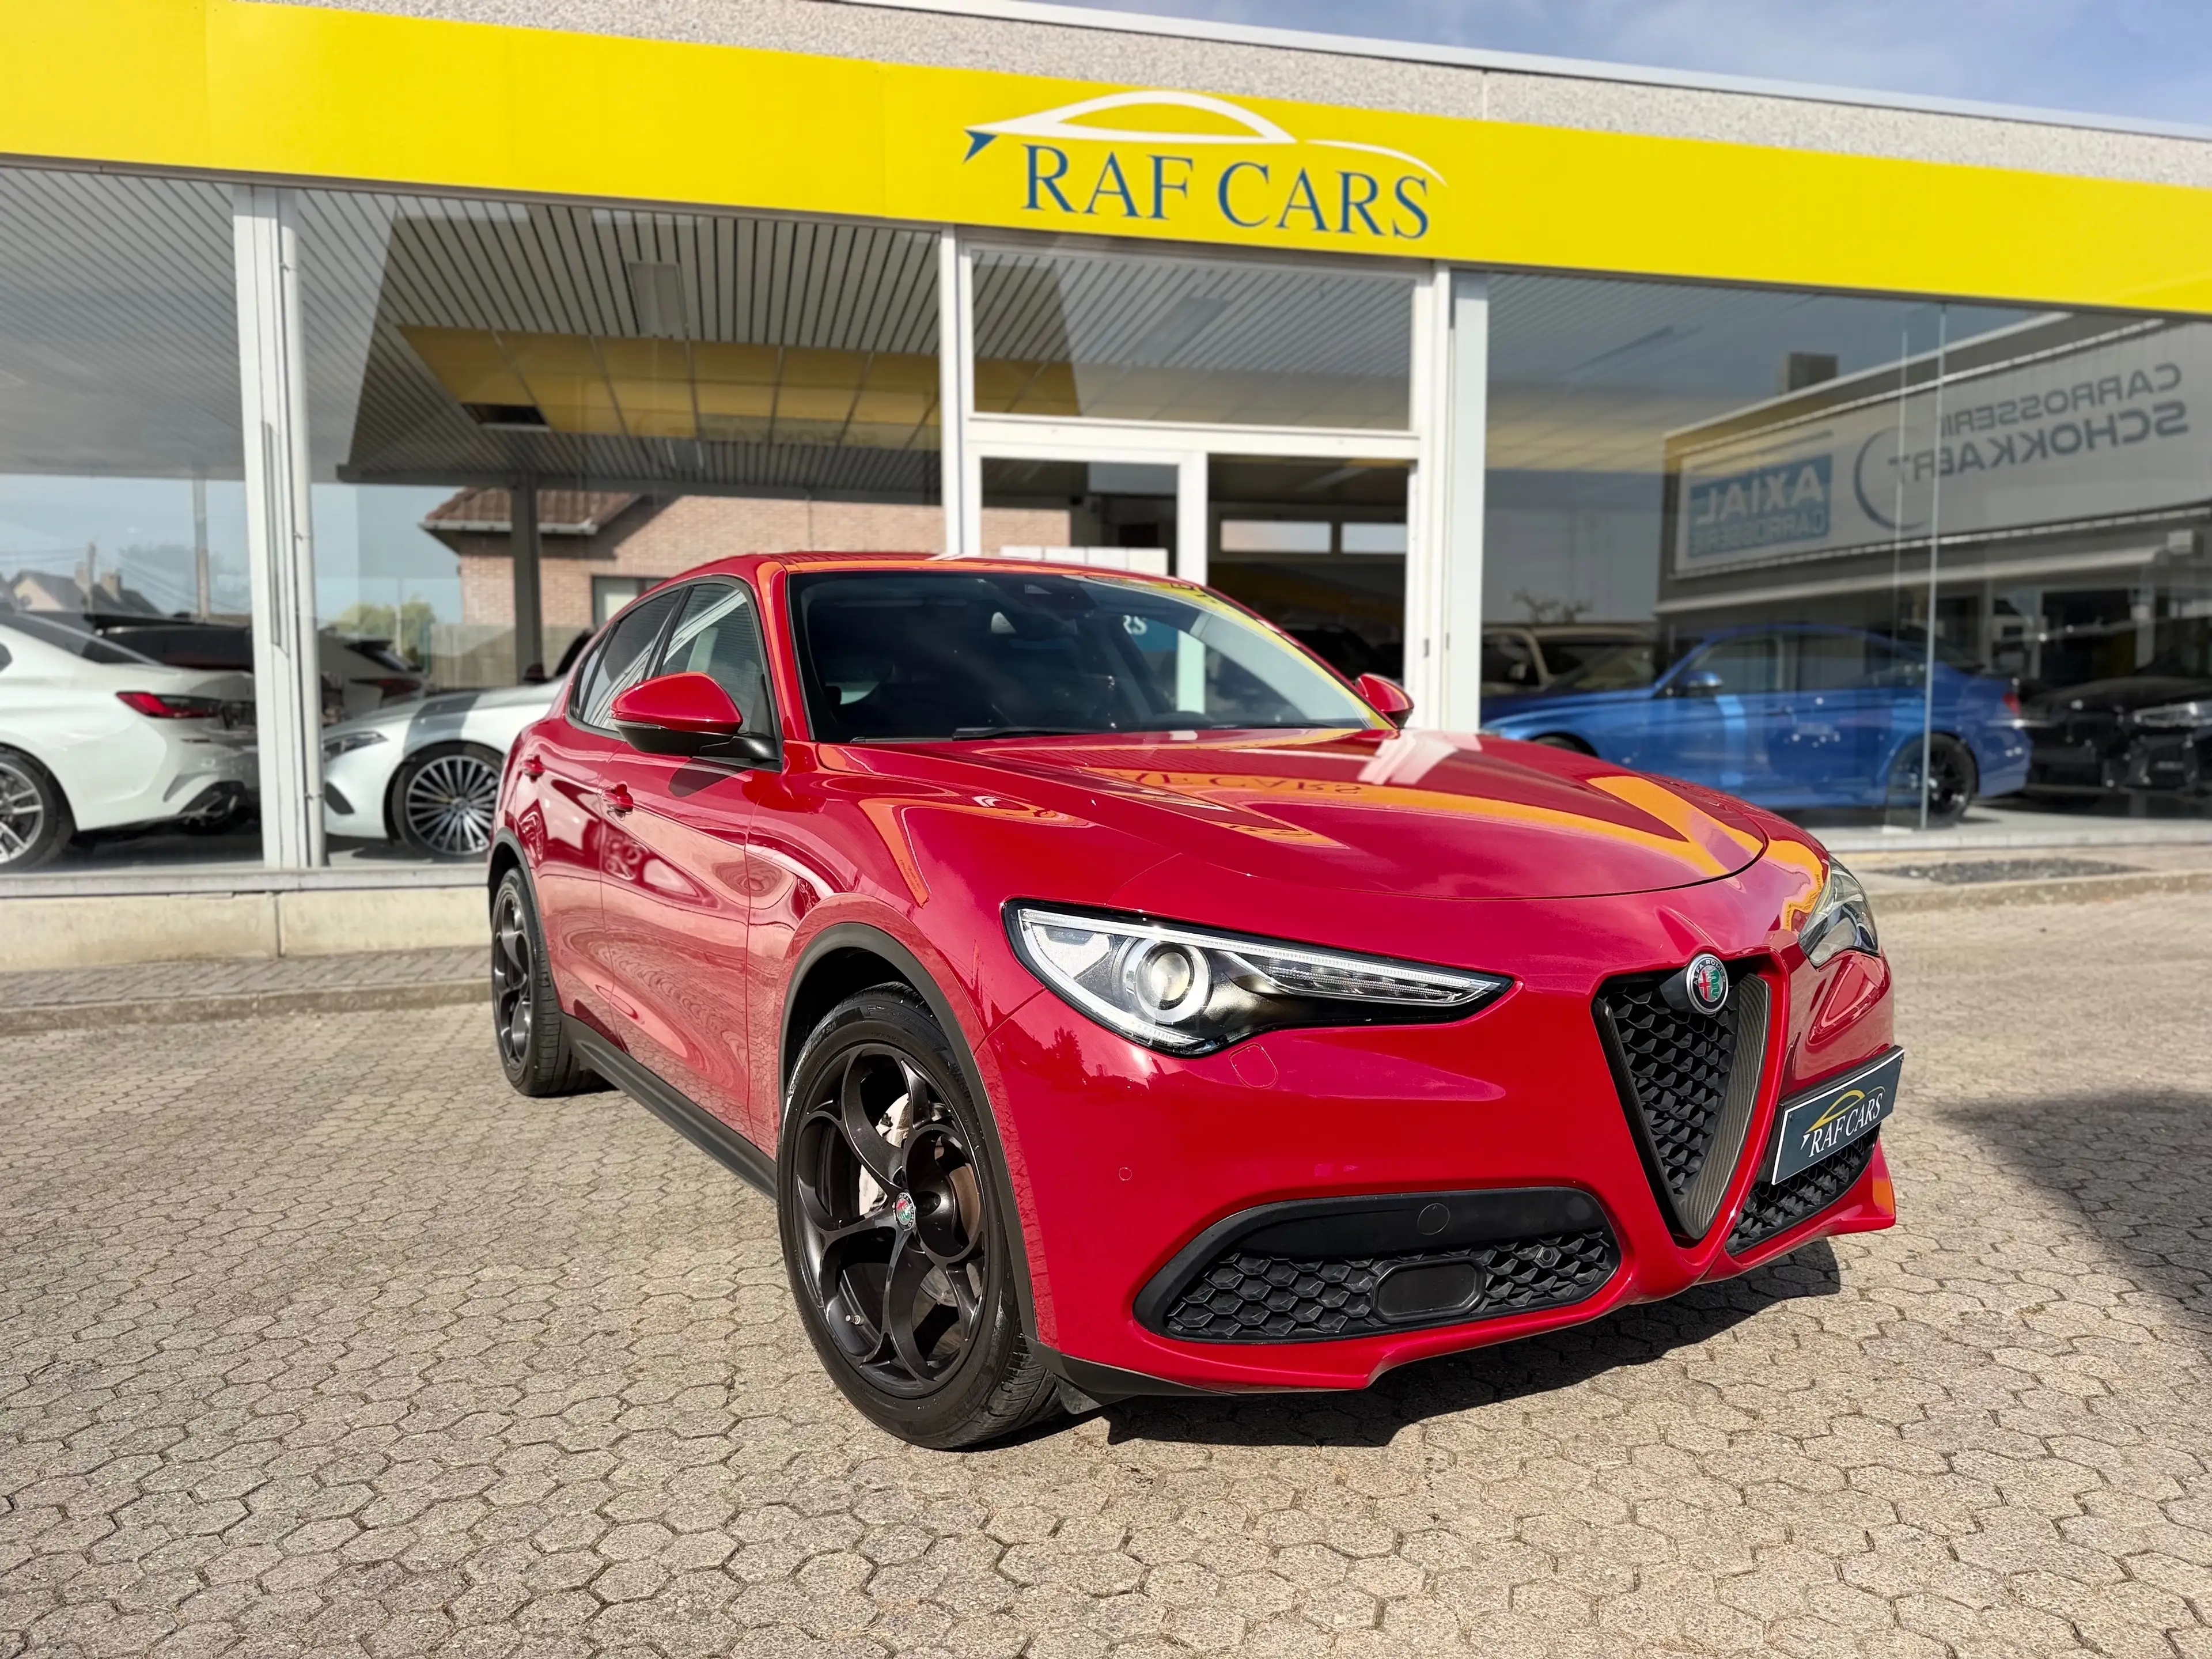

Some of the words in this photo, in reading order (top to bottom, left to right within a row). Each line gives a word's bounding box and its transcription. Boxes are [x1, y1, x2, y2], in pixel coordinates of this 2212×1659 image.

[1020, 142, 1194, 220] RAF
[1217, 161, 1429, 240] CARS
[1694, 964, 1705, 986] ALFA
[1705, 960, 1726, 983] ROMEO
[1808, 1115, 1846, 1158] RAF
[1845, 1092, 1883, 1137] CARS
